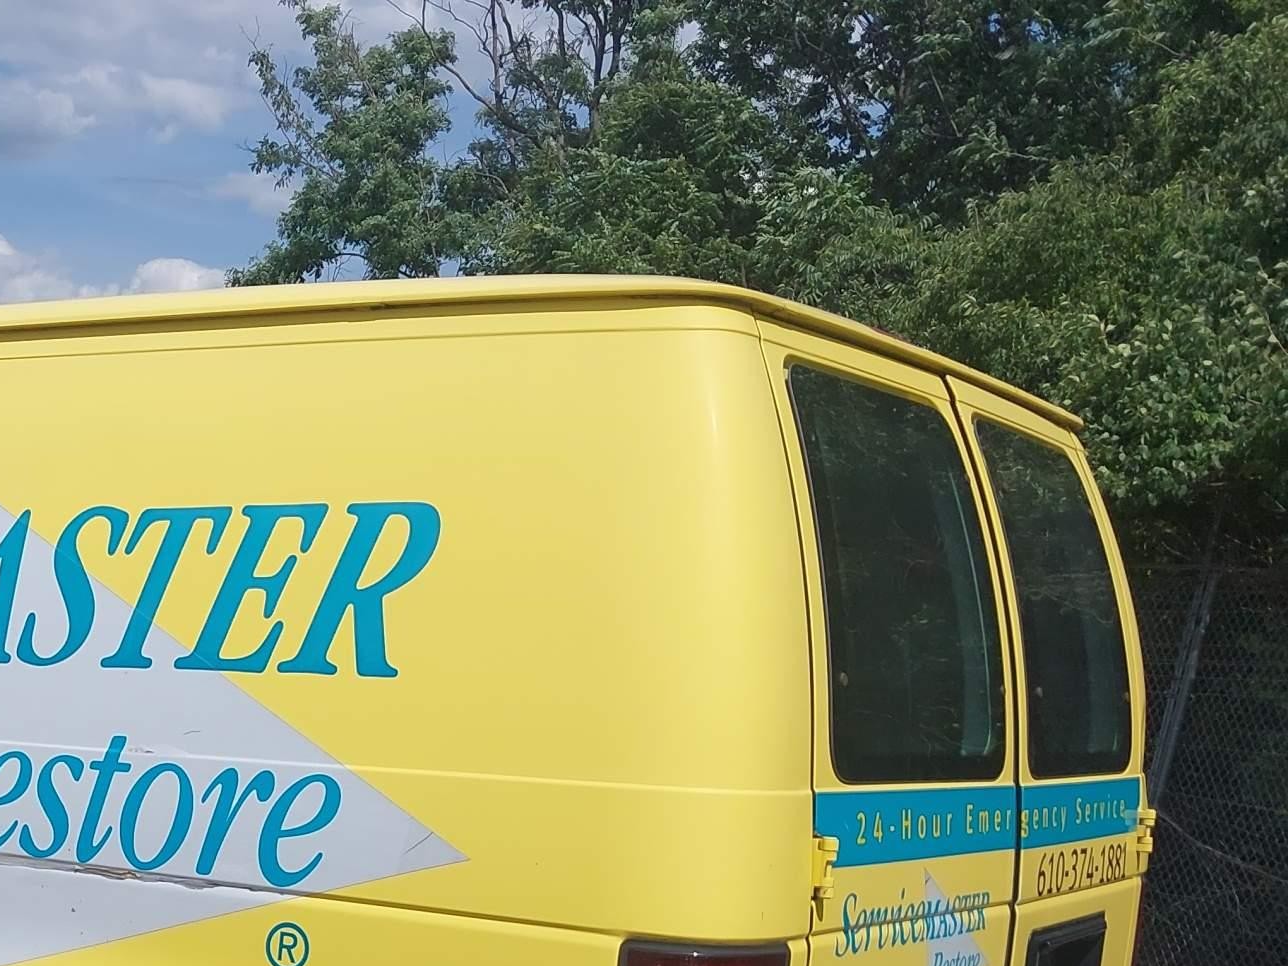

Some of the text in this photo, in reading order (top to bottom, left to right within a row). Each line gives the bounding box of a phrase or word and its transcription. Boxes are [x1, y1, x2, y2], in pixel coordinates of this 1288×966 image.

[856, 794, 1126, 845] 24-Hour Emergency Service
[1037, 842, 1128, 897] 610-374-1881
[835, 887, 990, 958] ServiceMASTER
